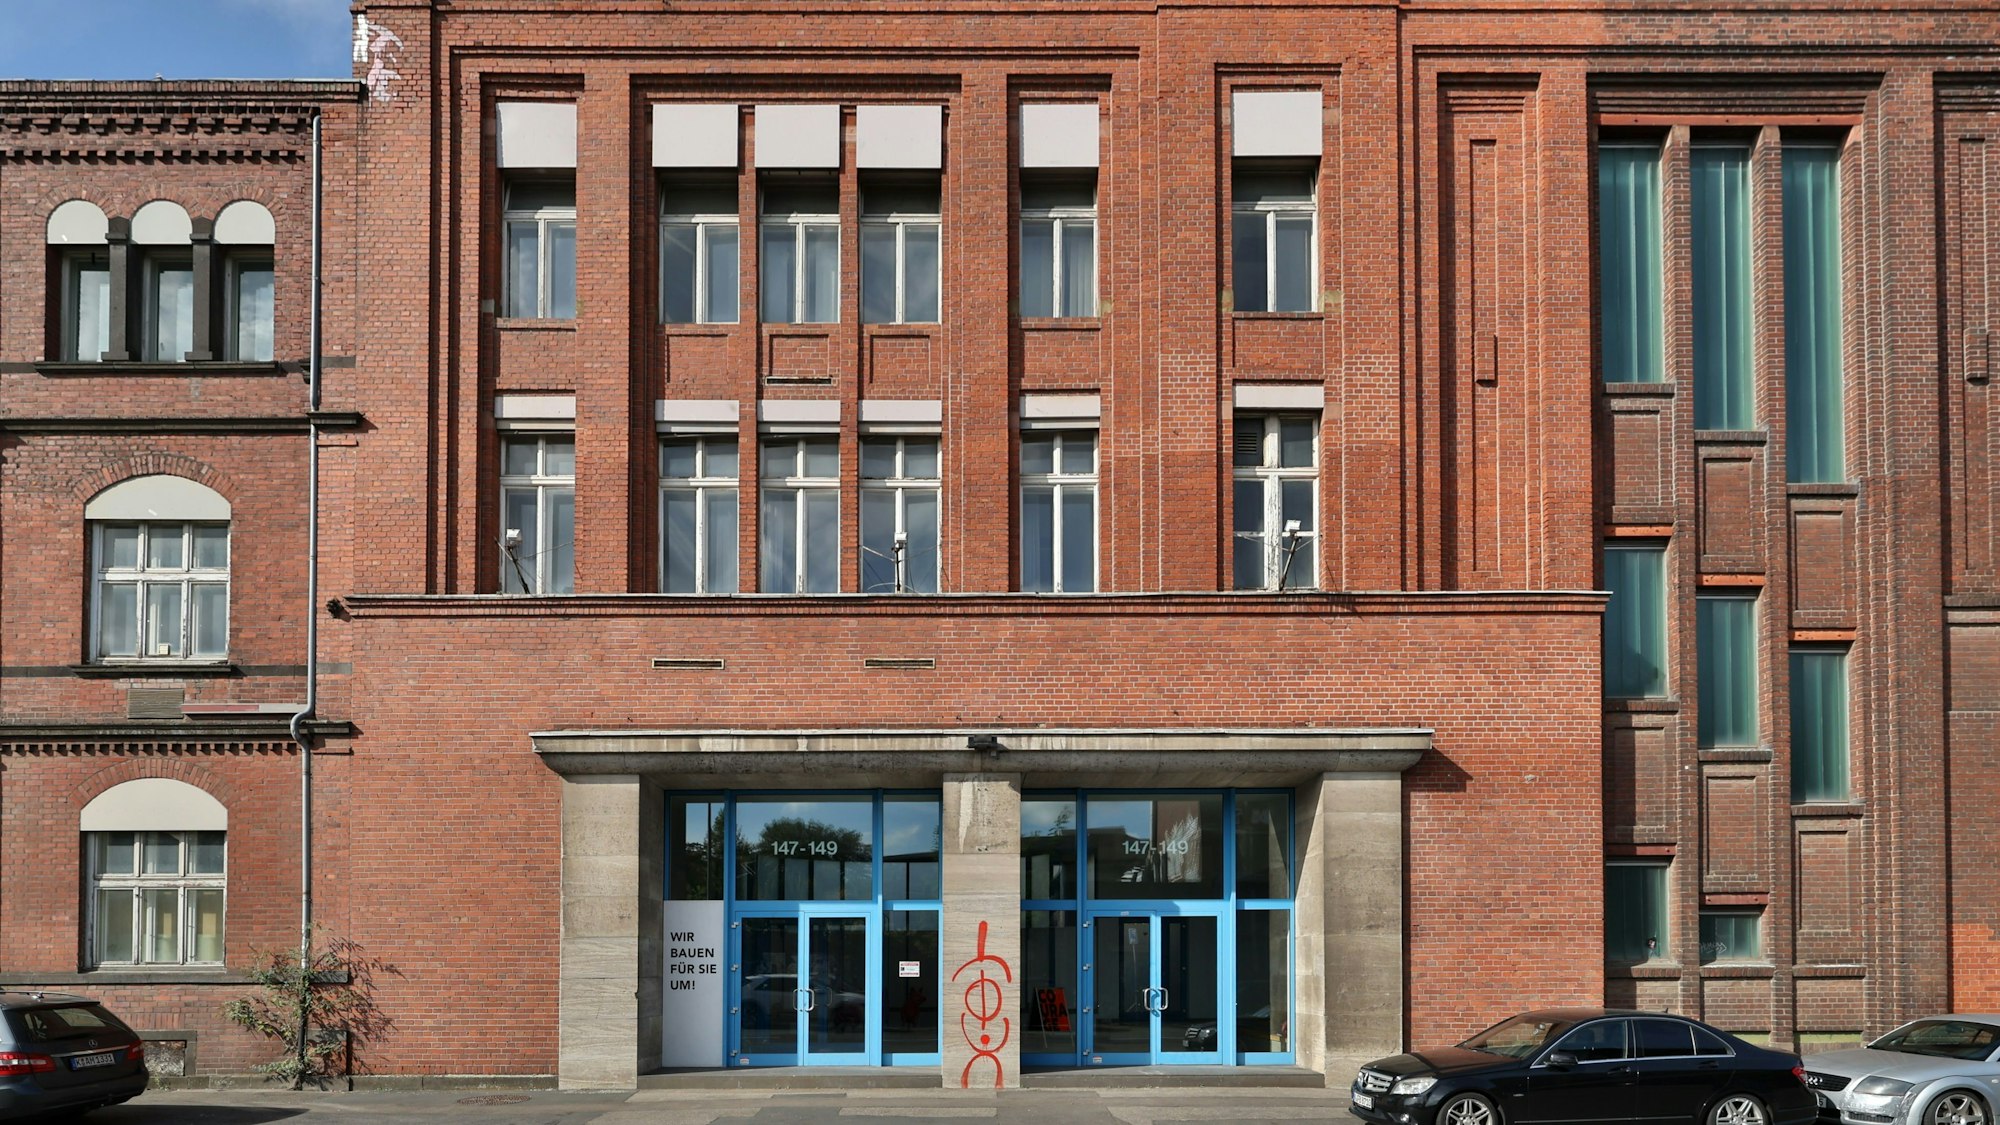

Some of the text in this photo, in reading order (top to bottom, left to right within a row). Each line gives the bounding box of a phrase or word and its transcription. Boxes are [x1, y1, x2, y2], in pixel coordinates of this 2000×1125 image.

[771, 841, 838, 856] 147-149
[670, 932, 695, 942] WIR
[670, 948, 714, 958] BAUEN
[670, 961, 717, 974] FÜR SIE
[670, 980, 695, 990] UM!
[1038, 988, 1056, 1003] CO
[1040, 1003, 1068, 1018] URA
